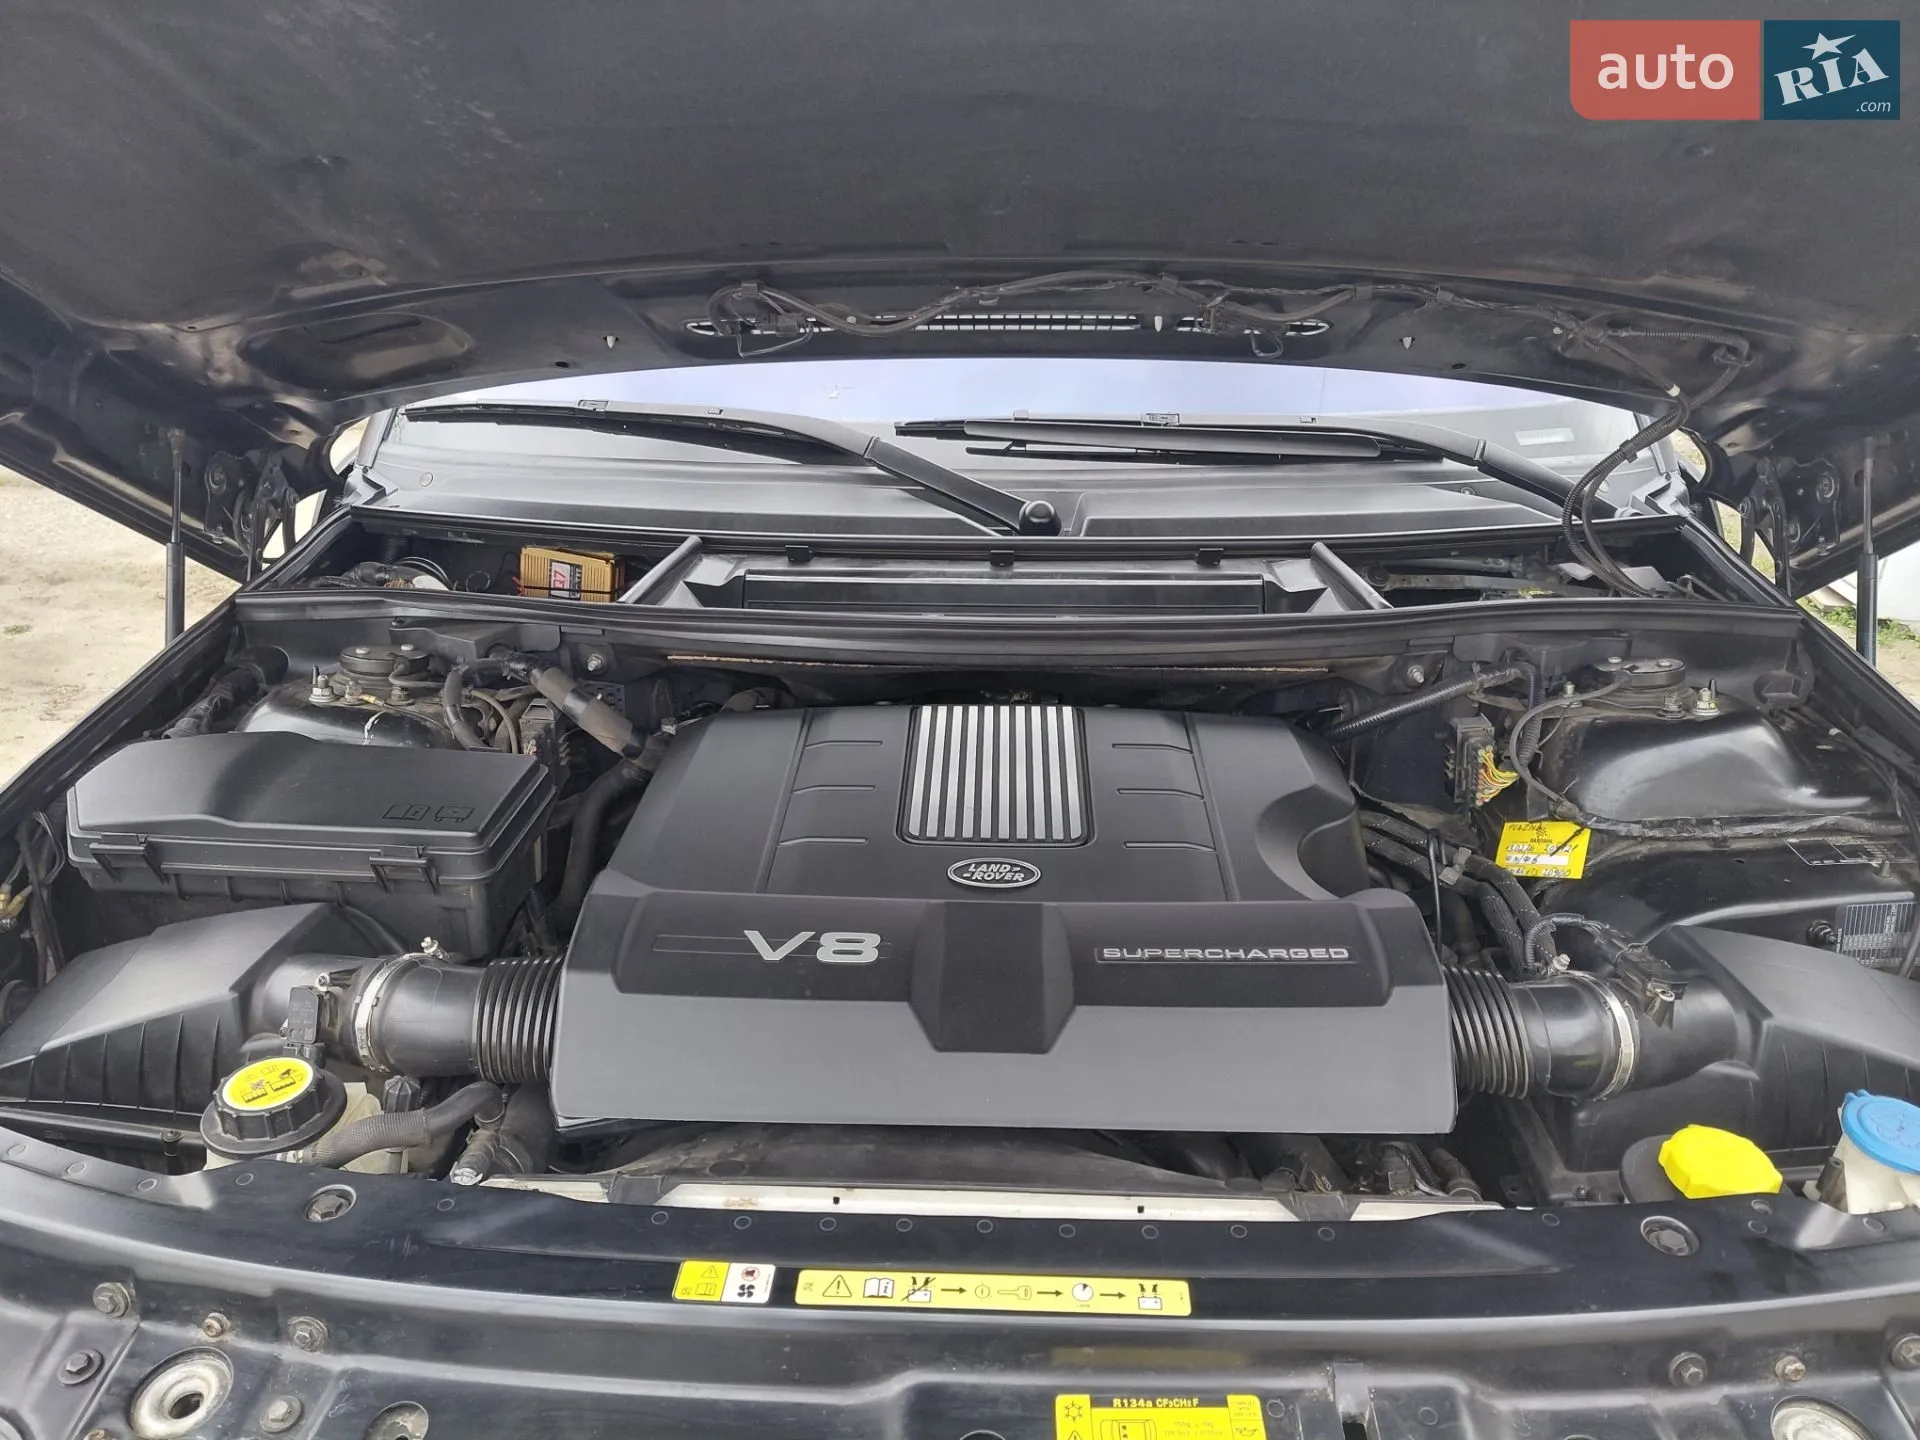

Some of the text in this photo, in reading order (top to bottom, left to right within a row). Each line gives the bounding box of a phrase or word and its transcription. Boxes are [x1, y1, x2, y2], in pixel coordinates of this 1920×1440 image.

[968, 864, 1011, 872] LAND
[972, 872, 1025, 881] ROVER
[744, 930, 881, 963] V8
[1103, 948, 1349, 959] SUPERCHARGED
[1112, 1398, 1153, 1408] R134a
